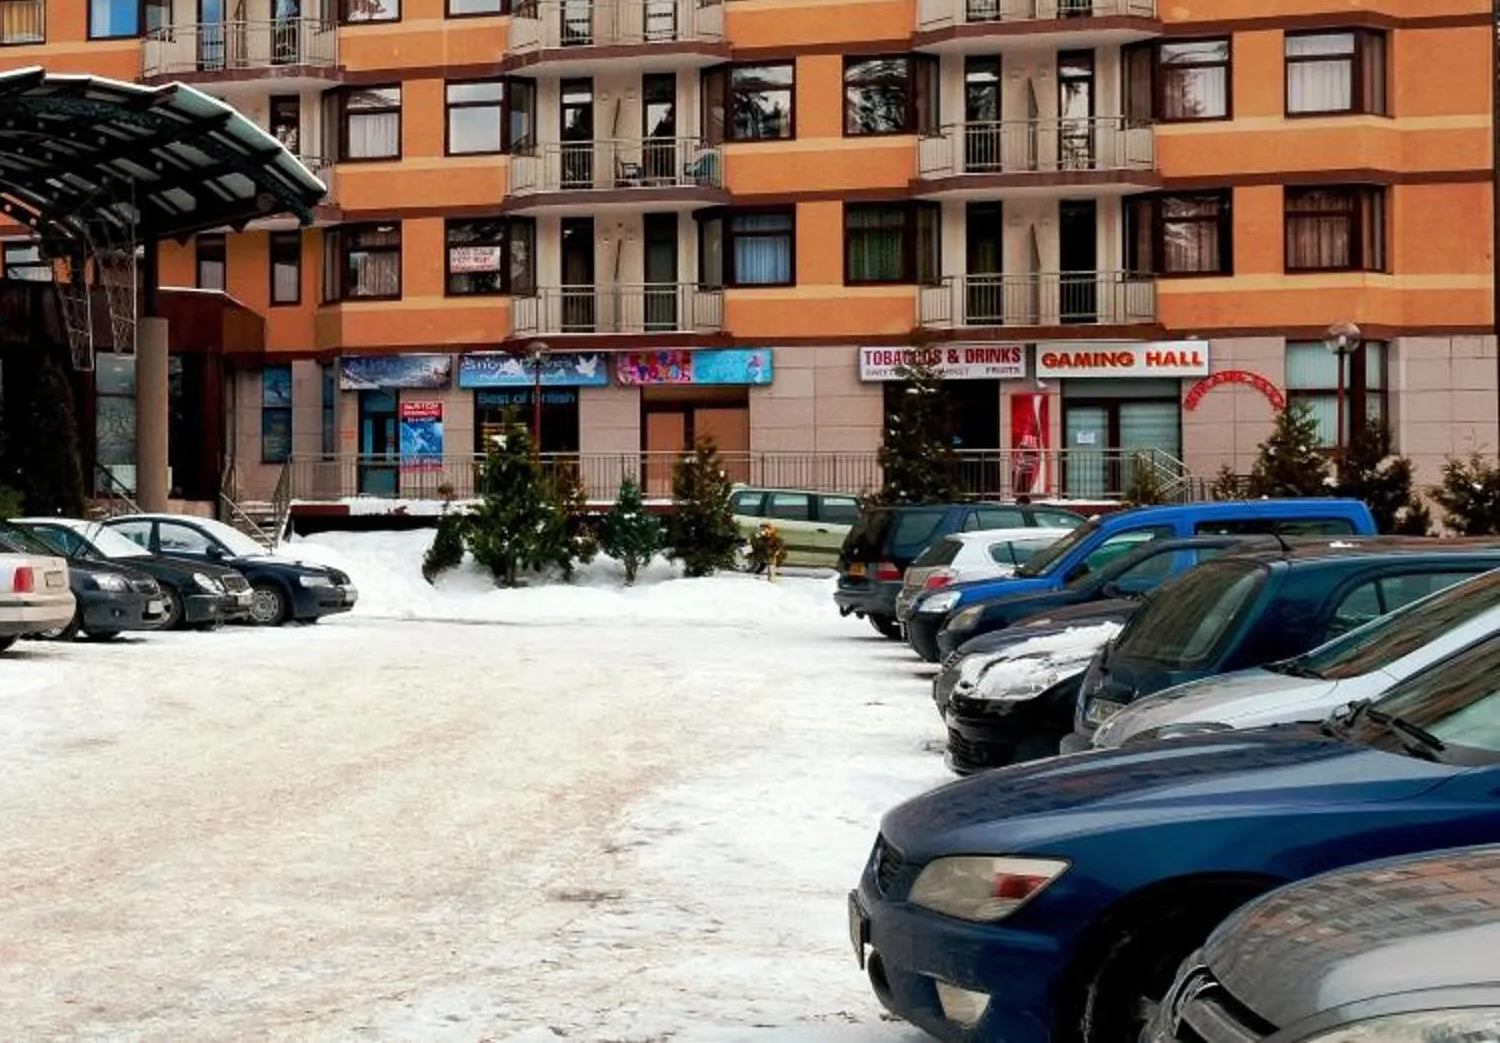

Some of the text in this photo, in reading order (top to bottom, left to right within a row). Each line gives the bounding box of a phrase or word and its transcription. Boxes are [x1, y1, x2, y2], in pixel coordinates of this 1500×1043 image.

[947, 348, 960, 364] &
[964, 346, 1021, 364] DRINKS
[1041, 350, 1204, 368] GAMING HALL
